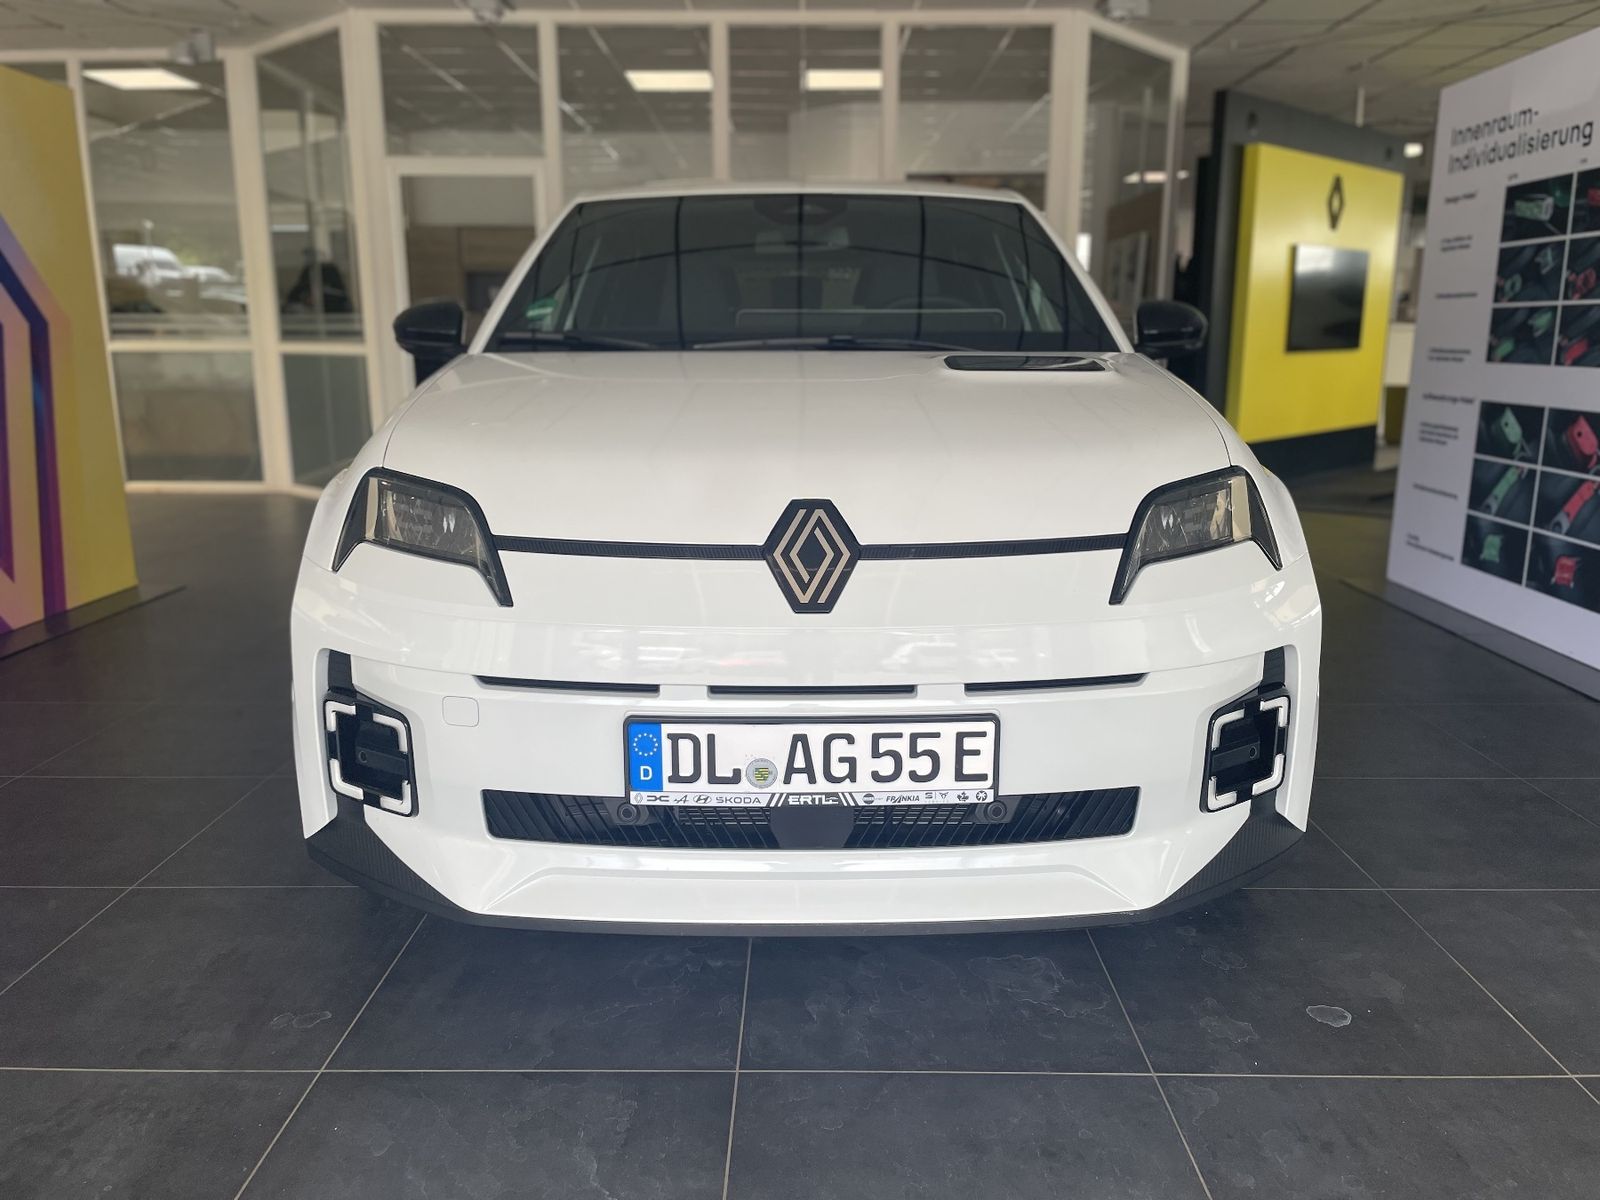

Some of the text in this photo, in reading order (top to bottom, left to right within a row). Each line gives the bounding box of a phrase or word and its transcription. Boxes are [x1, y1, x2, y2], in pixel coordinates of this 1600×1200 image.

[1447, 120, 1594, 175] Individualisierung
[1450, 108, 1539, 147] Innenraum-
[640, 766, 653, 781] D
[667, 733, 742, 784] DL
[783, 733, 857, 784] AG
